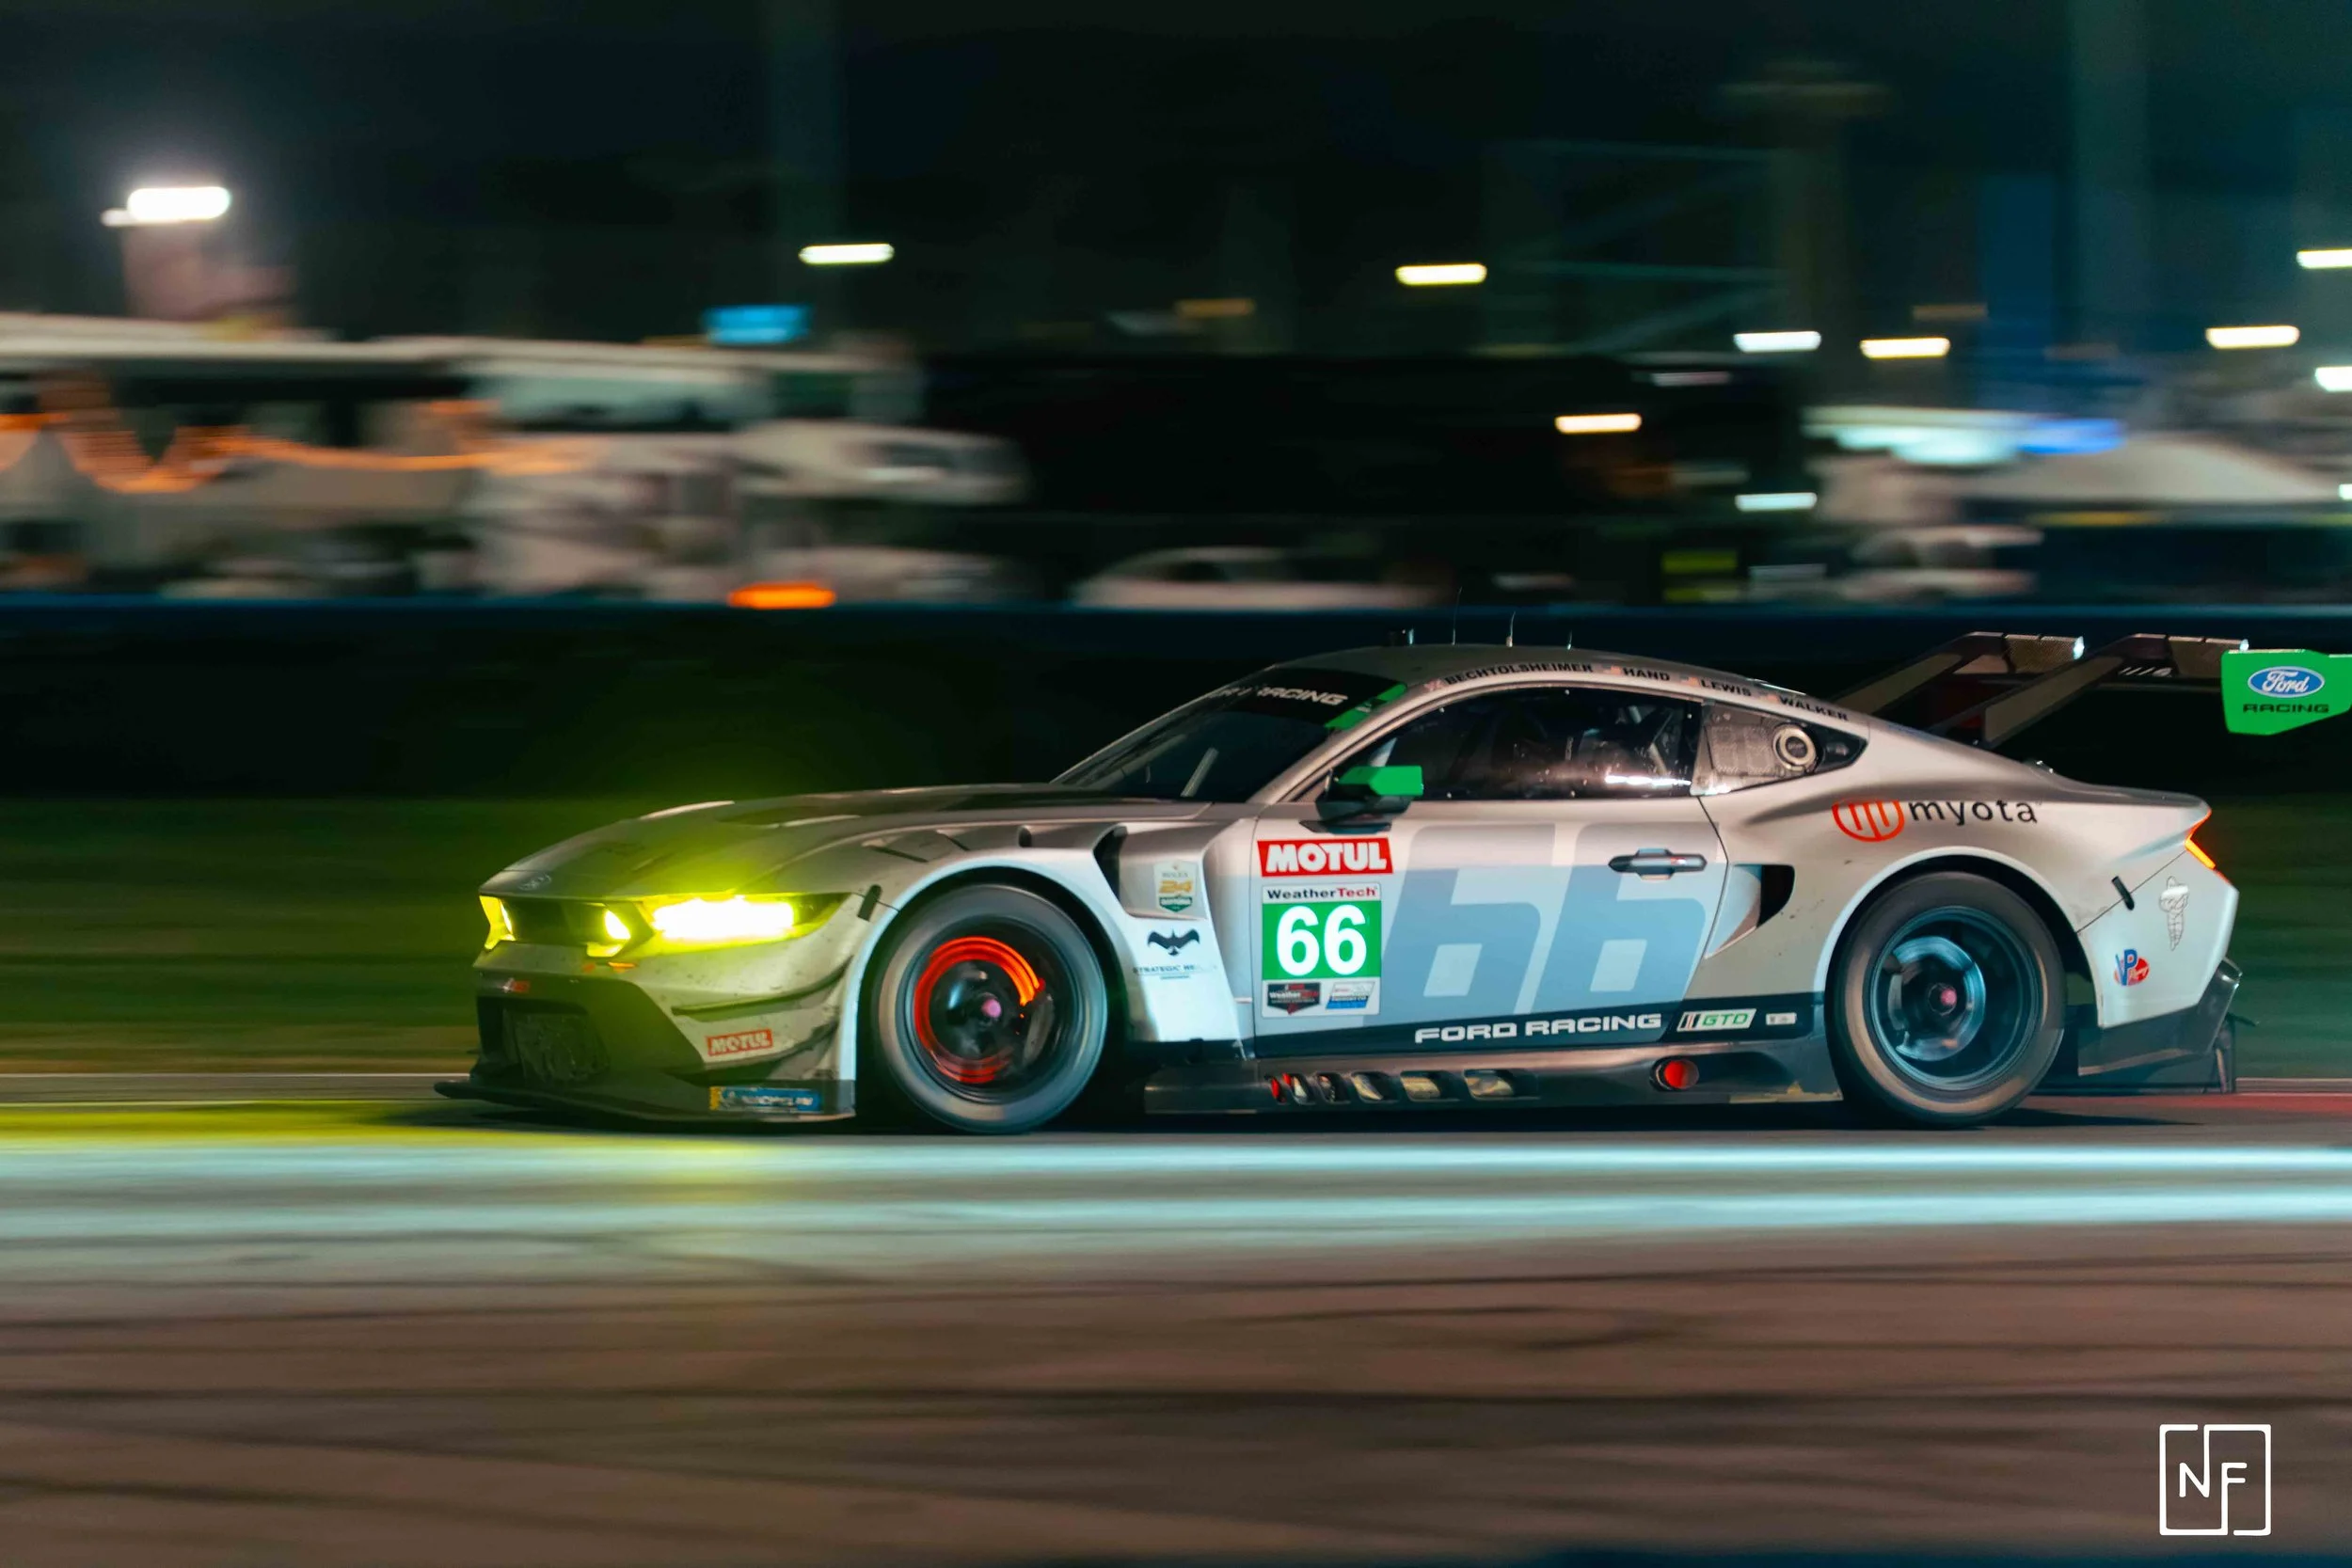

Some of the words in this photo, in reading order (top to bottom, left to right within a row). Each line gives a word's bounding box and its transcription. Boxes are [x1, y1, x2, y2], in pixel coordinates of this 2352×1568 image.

[1444, 661, 1594, 686] BECHTOLSHEIMER
[1623, 666, 1671, 683] HAND
[1700, 678, 1753, 697] LEWIS
[1779, 694, 1850, 722] WALKER
[2262, 667, 2310, 694] Ford
[2243, 702, 2329, 715] RACING
[1909, 797, 2038, 827] myota
[1265, 842, 1388, 873] MOTUL
[1267, 886, 1376, 900] WeatherTech
[1276, 904, 1367, 976] 66
[2115, 949, 2137, 986] VP
[1414, 1022, 1518, 1044] FORD
[1525, 1012, 1662, 1037] RACING
[1702, 1013, 1749, 1026] GTD
[711, 1032, 768, 1053] MOTUL
